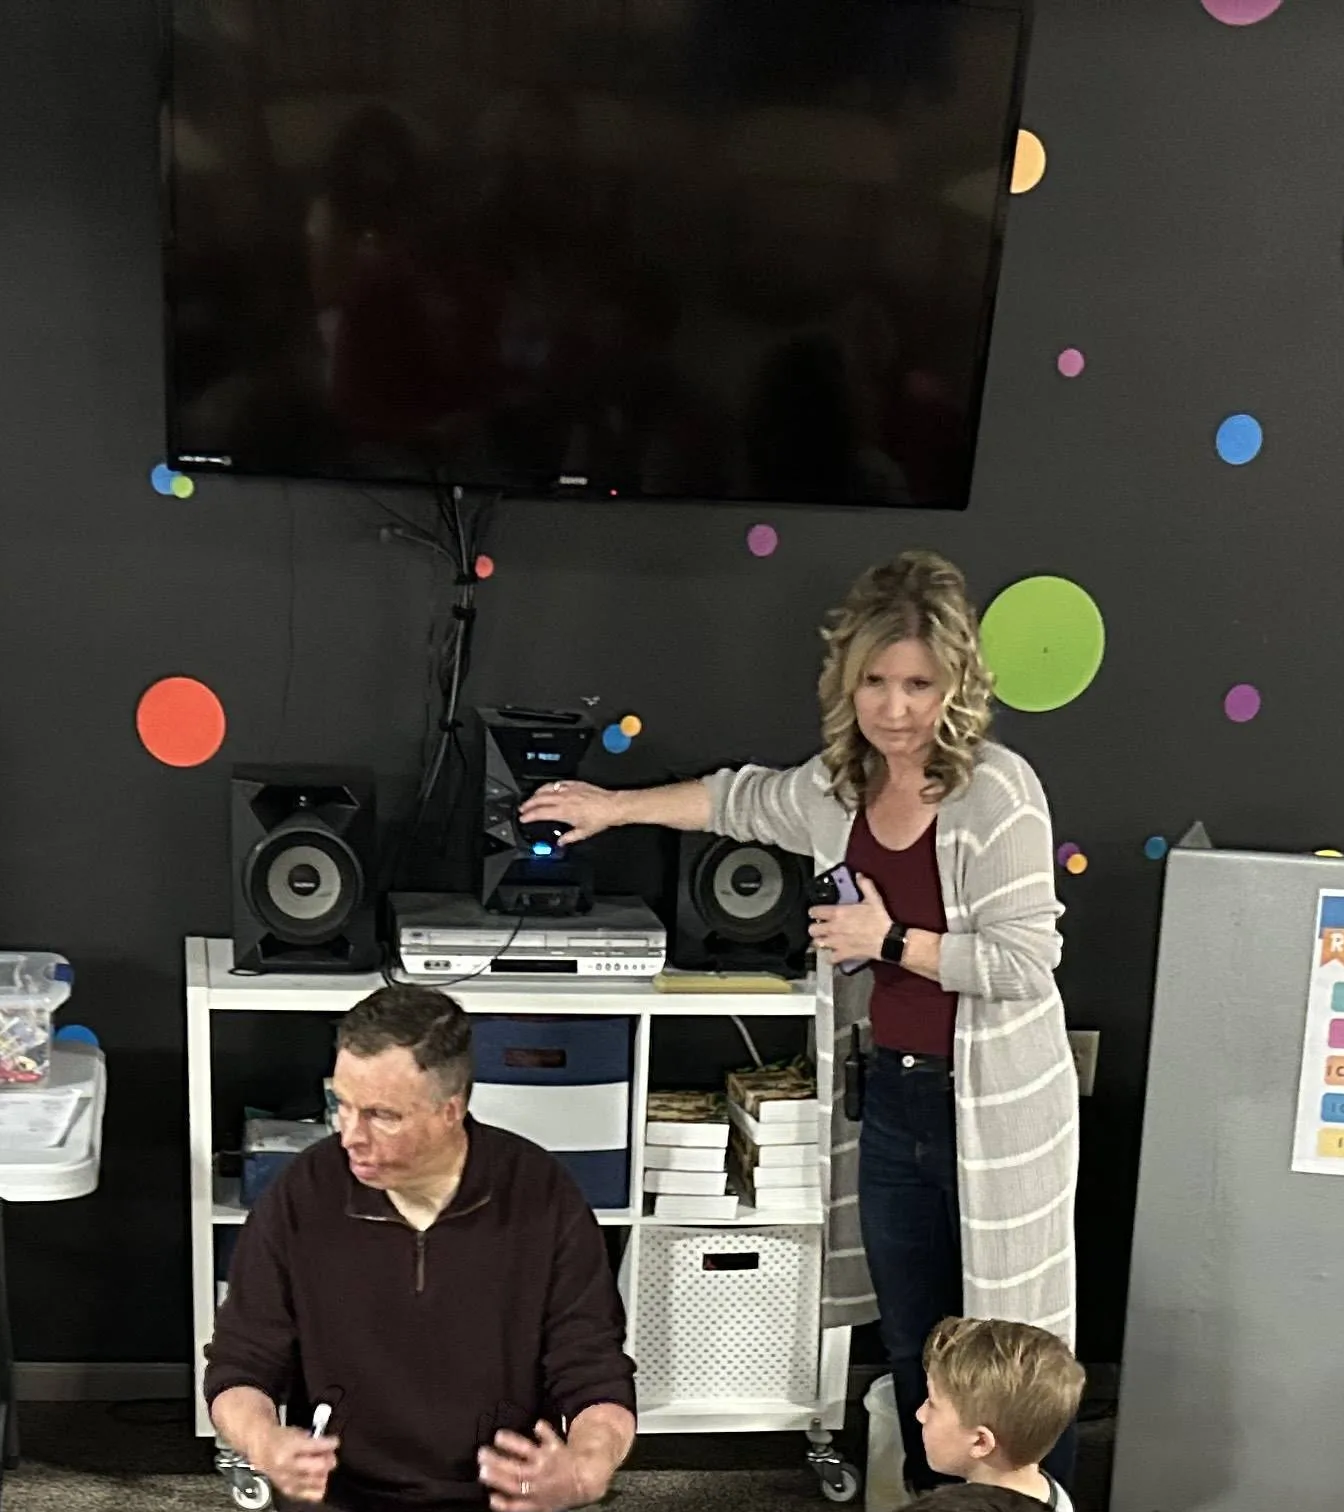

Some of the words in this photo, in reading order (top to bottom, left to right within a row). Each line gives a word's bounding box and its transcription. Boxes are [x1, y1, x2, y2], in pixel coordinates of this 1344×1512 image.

[1327, 1065, 1332, 1076] I
[1331, 1102, 1336, 1113] I
[1338, 1137, 1343, 1148] I
